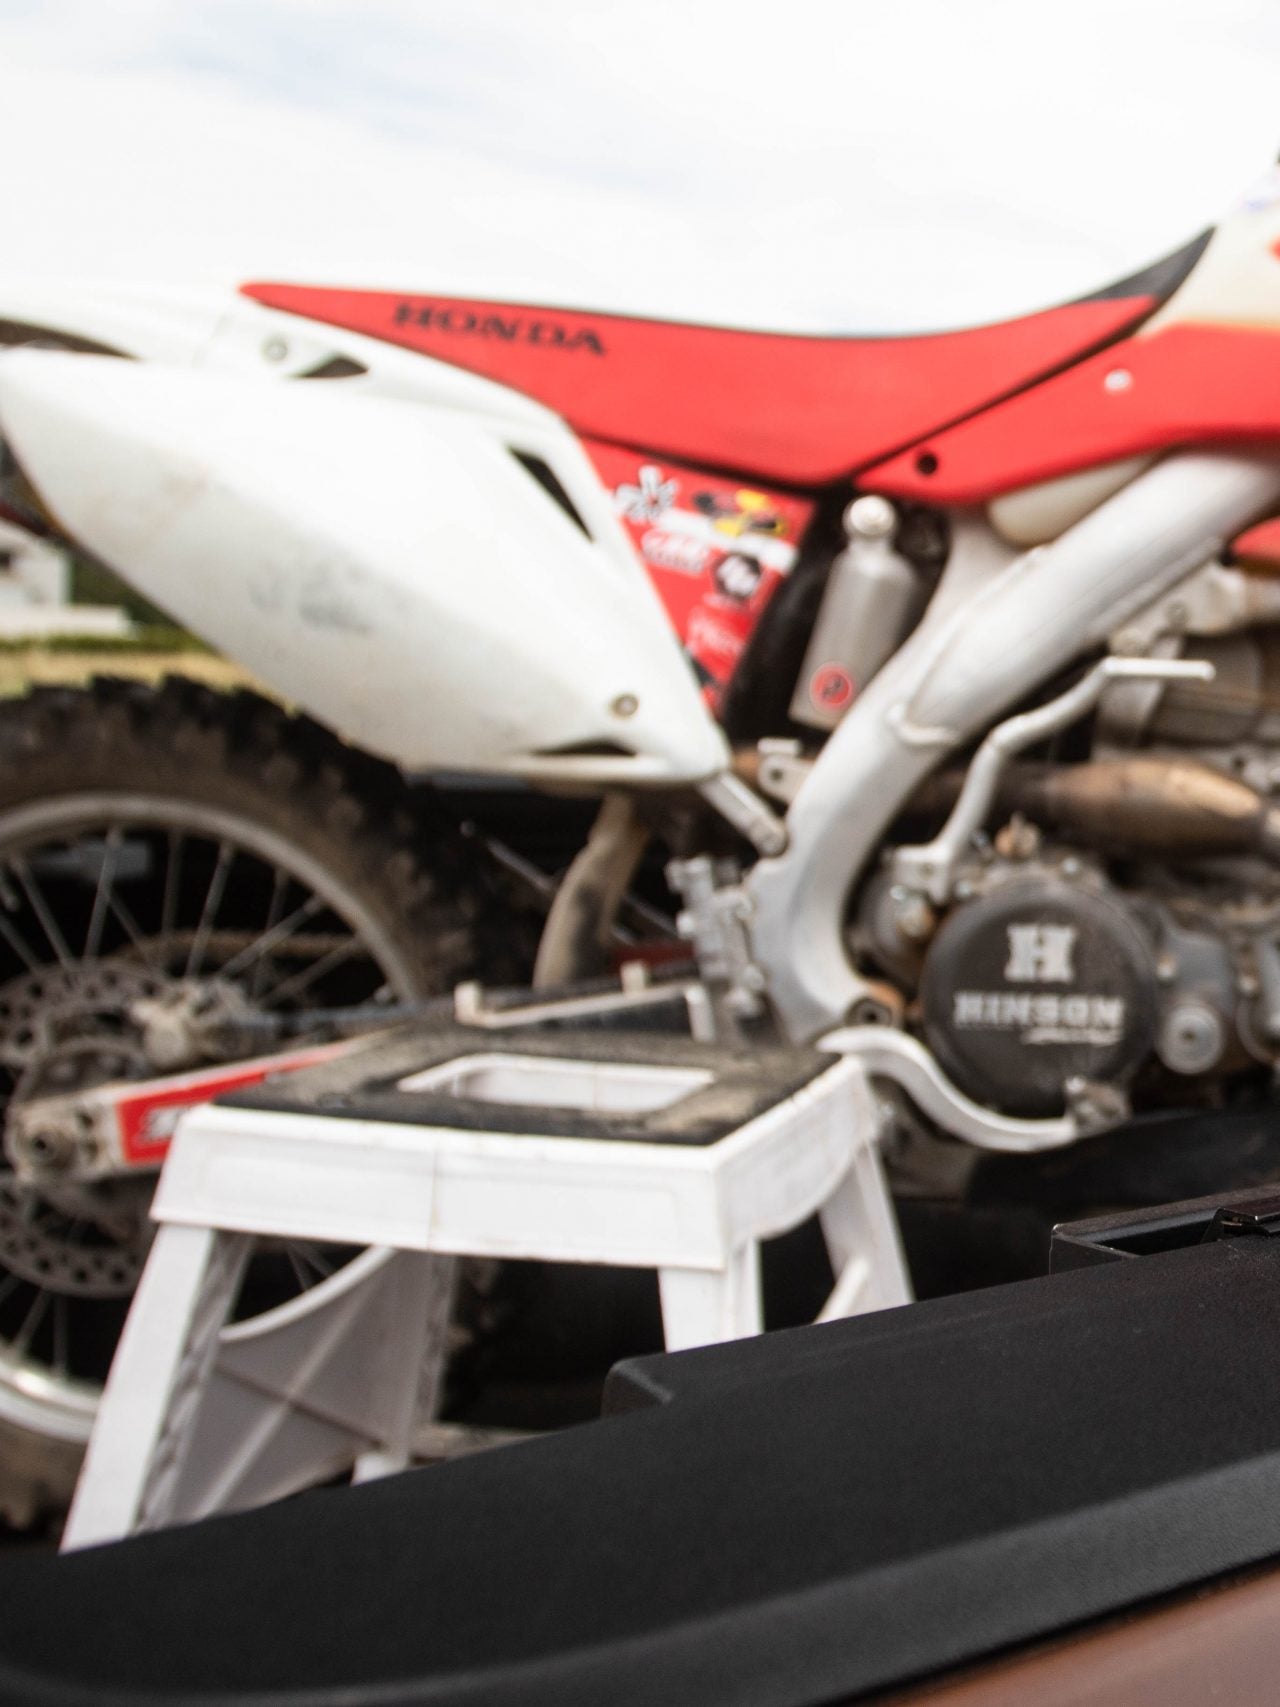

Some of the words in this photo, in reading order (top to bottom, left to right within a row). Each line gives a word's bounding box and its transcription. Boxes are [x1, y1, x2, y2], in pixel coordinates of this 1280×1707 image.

[393, 303, 606, 356] HONDA
[1004, 923, 1076, 984] H
[953, 991, 1125, 1030] HINSON
